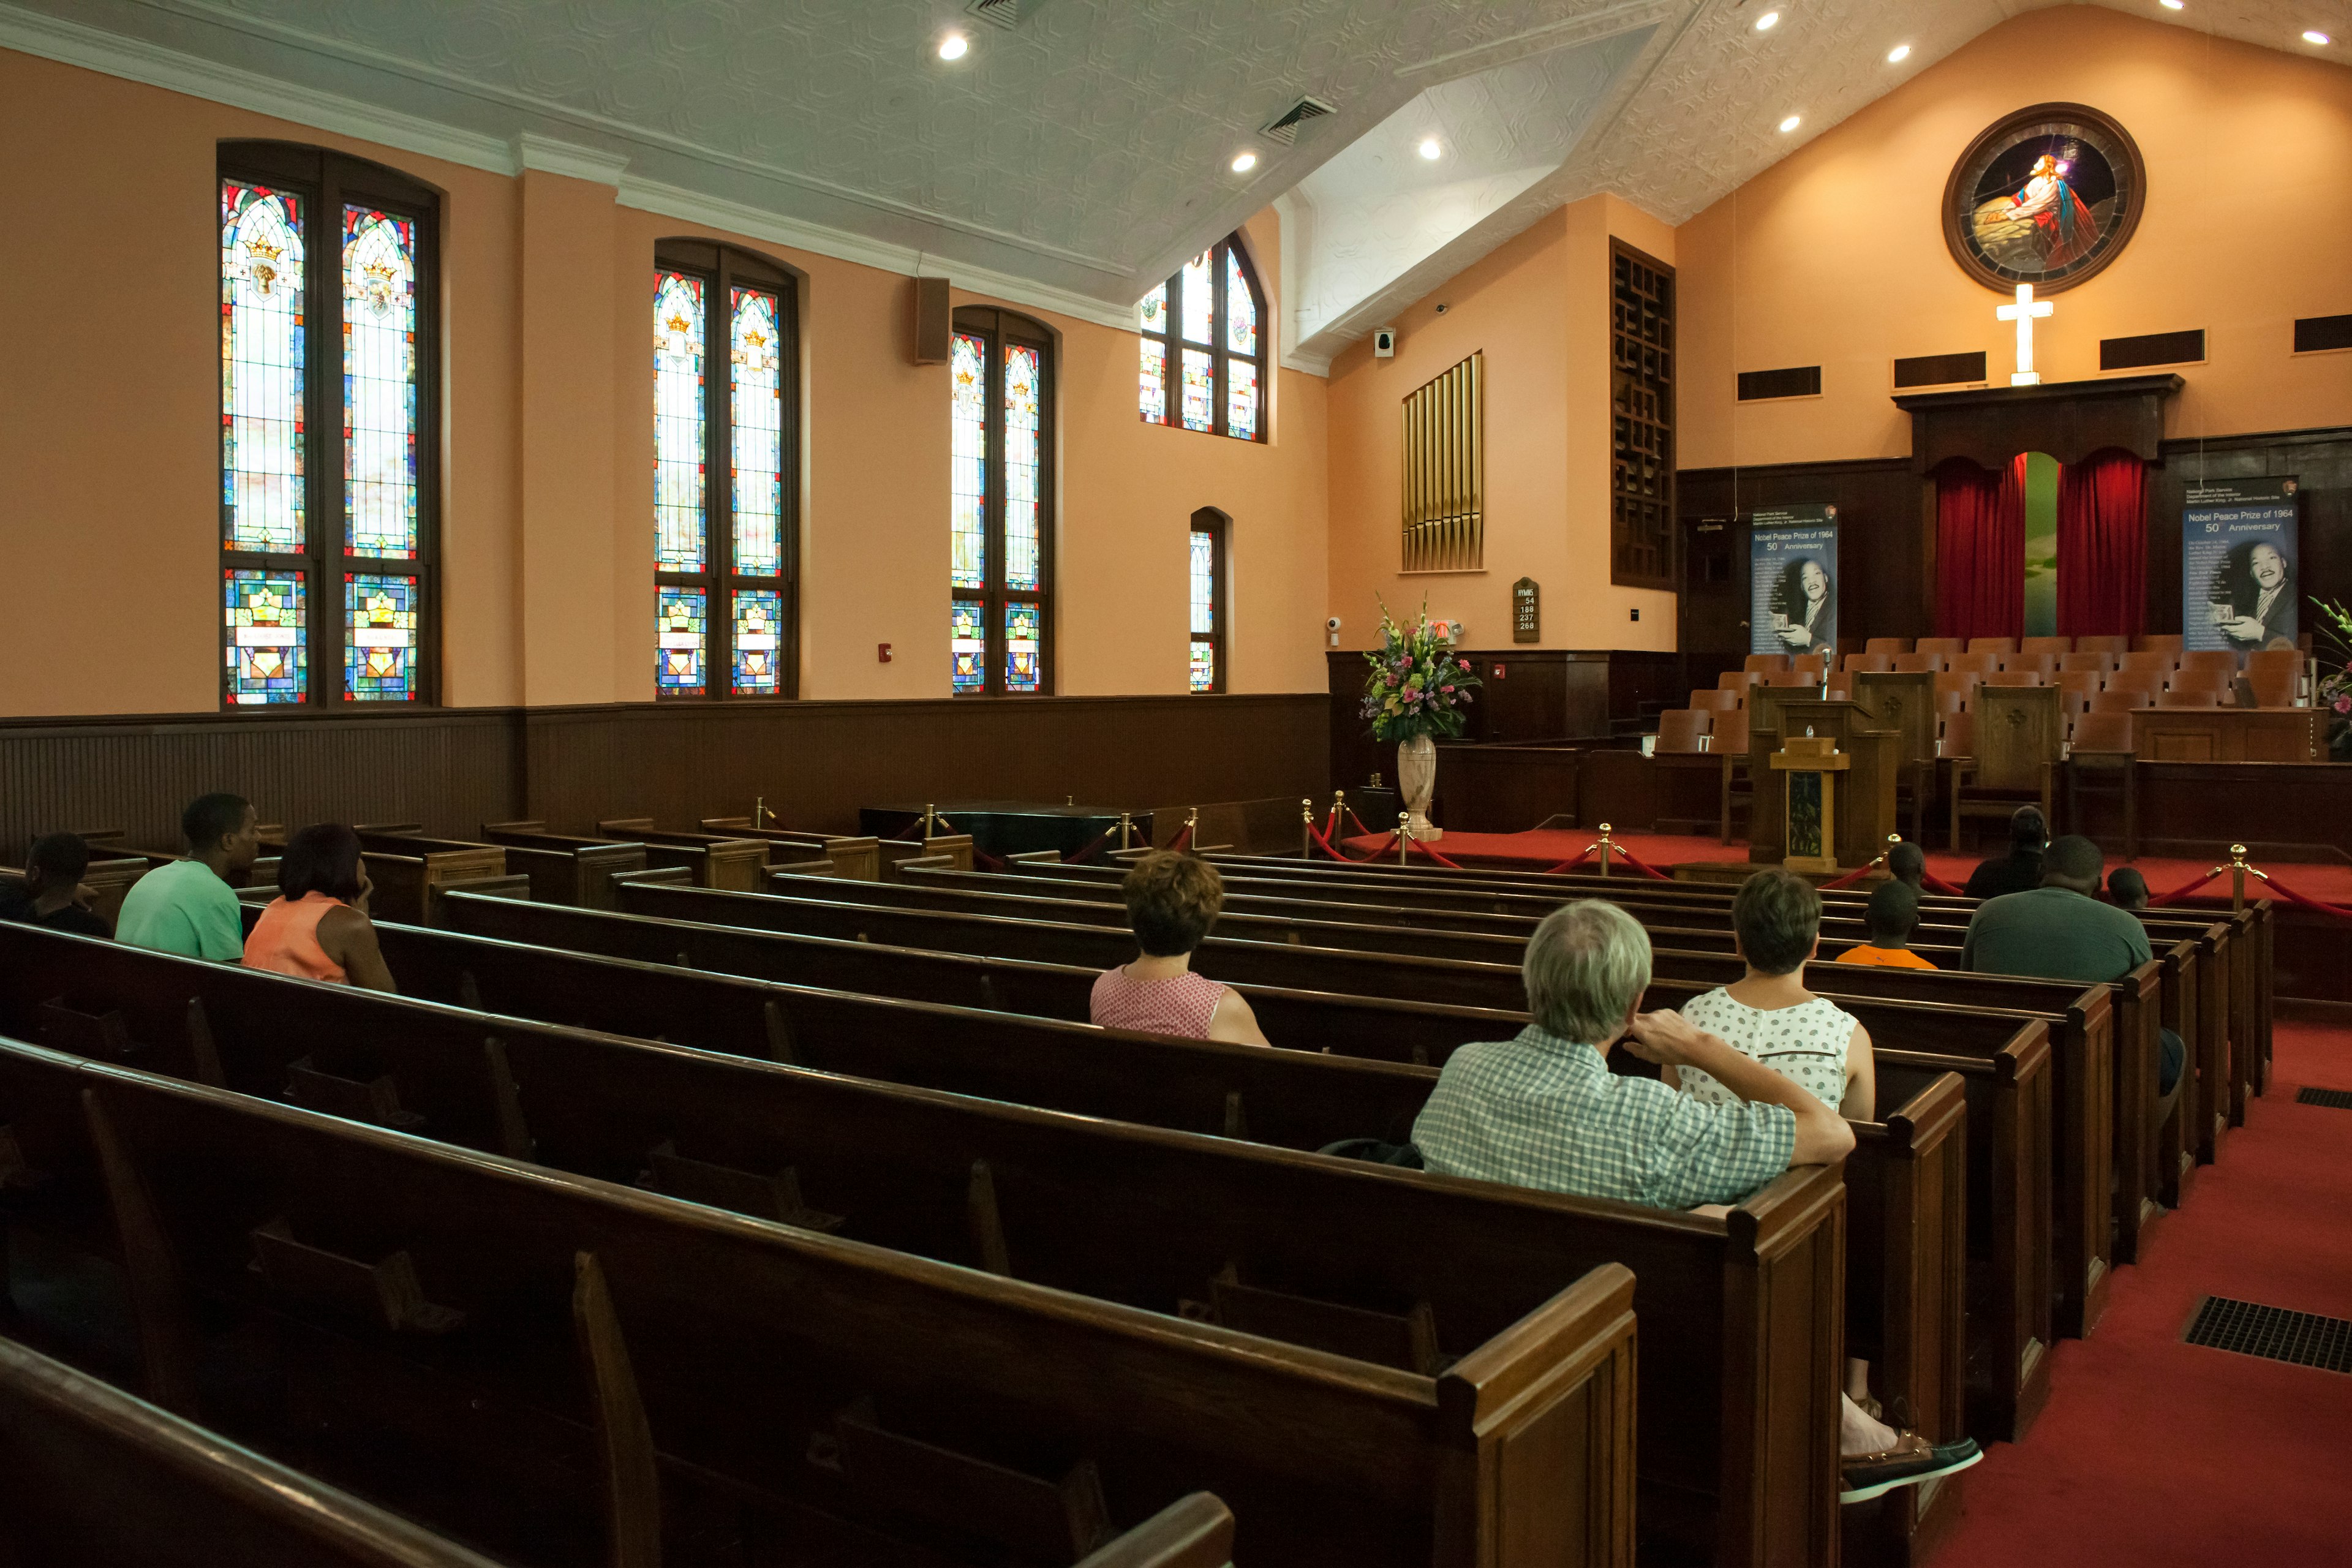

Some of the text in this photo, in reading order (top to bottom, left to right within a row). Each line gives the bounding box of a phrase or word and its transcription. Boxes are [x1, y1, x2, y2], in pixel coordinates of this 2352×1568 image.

[2188, 510, 2293, 522] Nobel Peace Prize of 1964
[2205, 523, 2219, 532] 50
[2228, 523, 2281, 532] Anniversary
[1773, 532, 1792, 541] Peace
